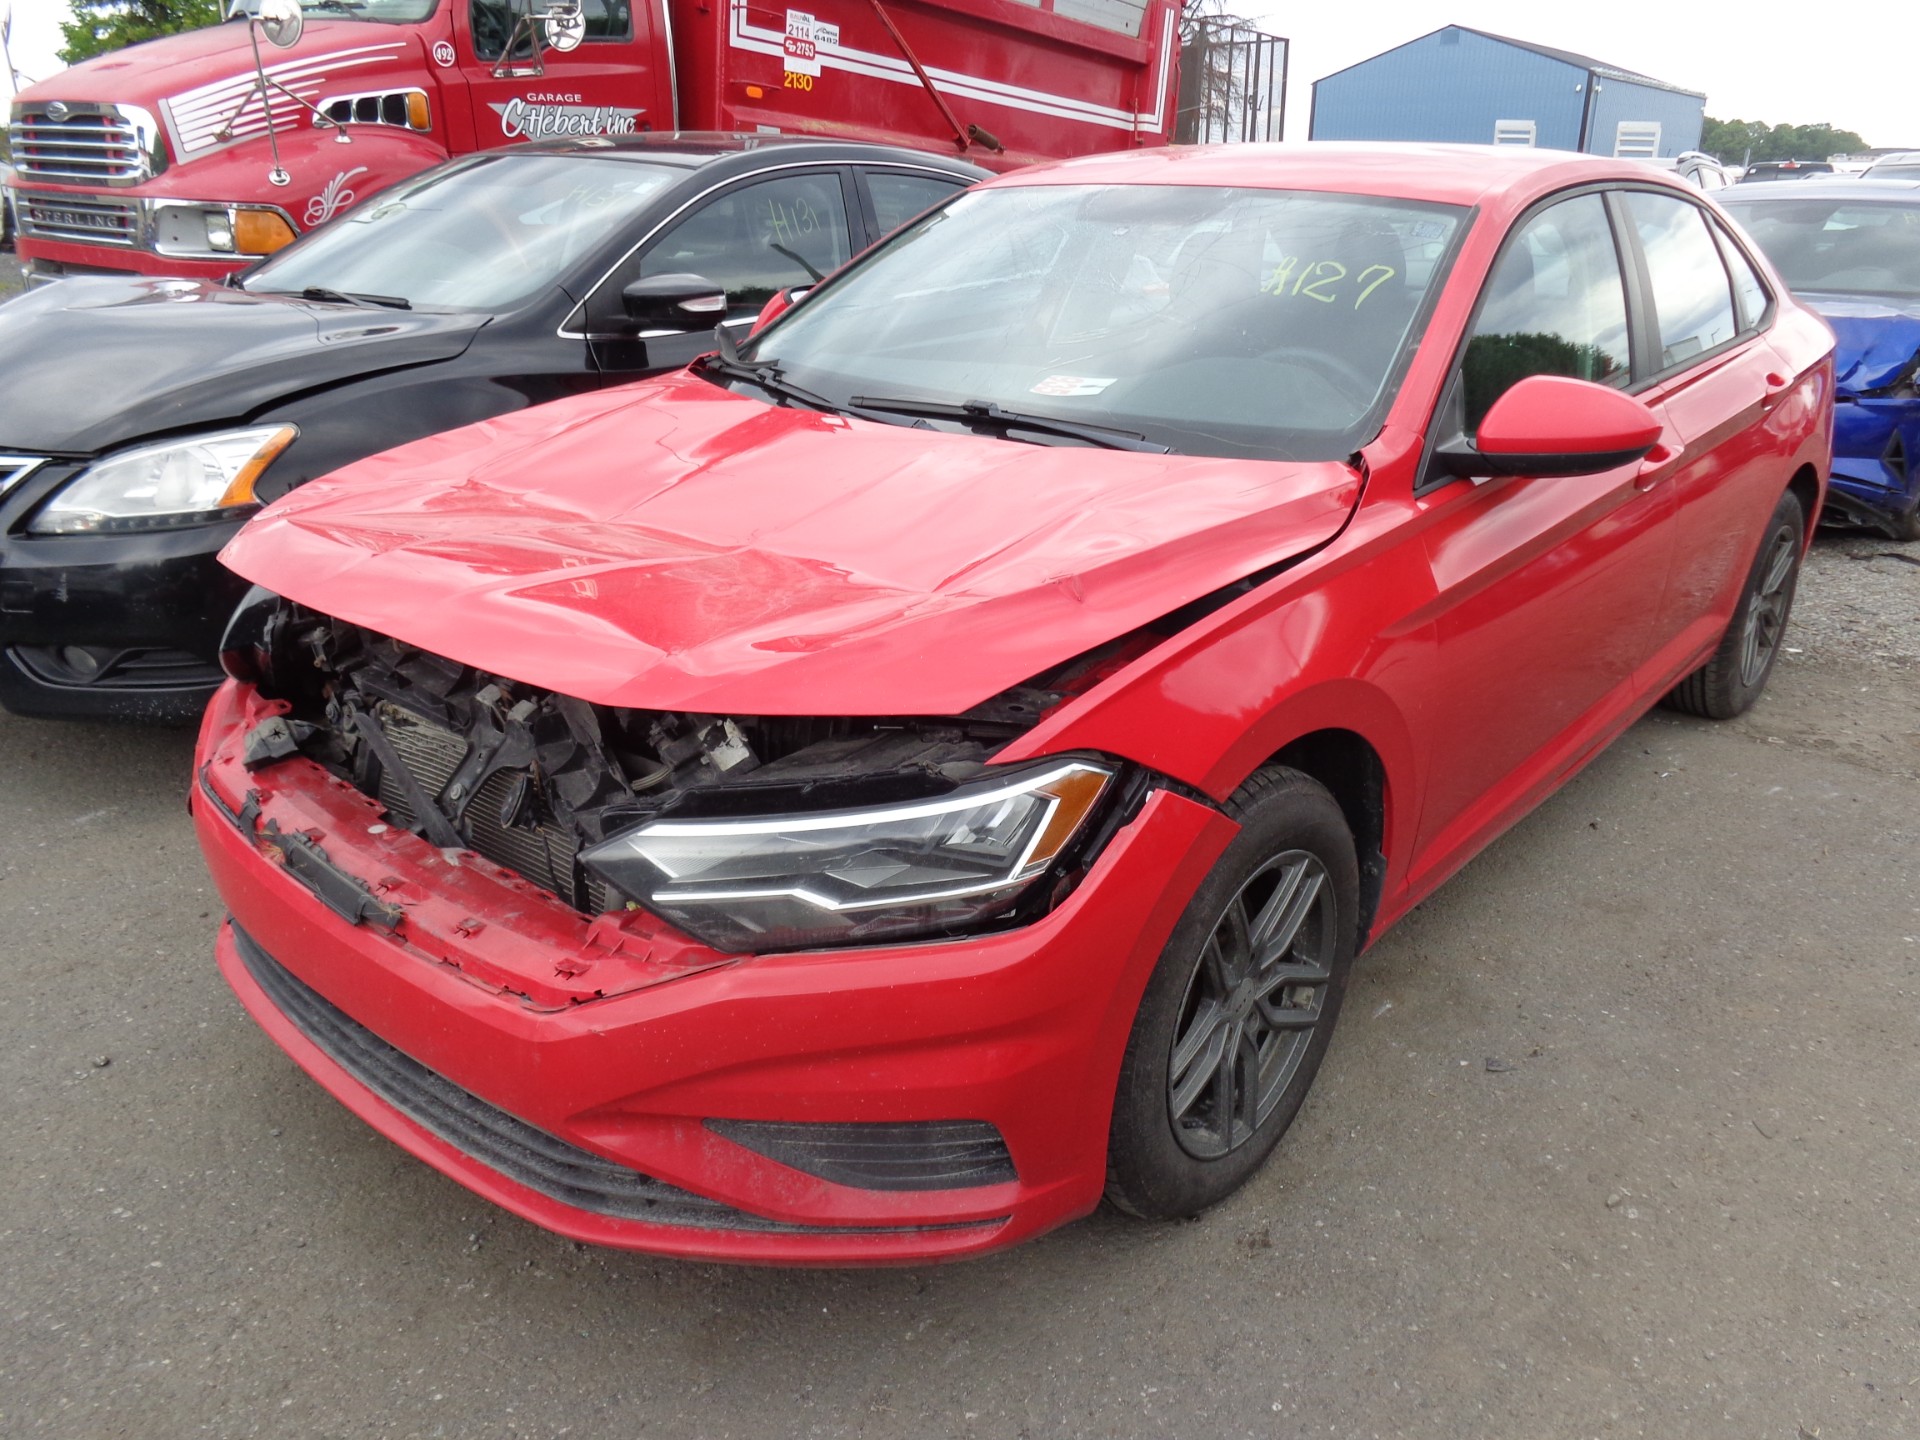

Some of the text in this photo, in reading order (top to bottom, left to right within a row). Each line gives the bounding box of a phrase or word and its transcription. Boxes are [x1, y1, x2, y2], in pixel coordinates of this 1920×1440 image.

[788, 23, 810, 39] 2114
[436, 47, 452, 61] 492
[796, 41, 813, 57] 2753
[784, 71, 812, 91] 2130
[526, 92, 582, 103] GARAGE
[34, 209, 118, 227] STERLING
